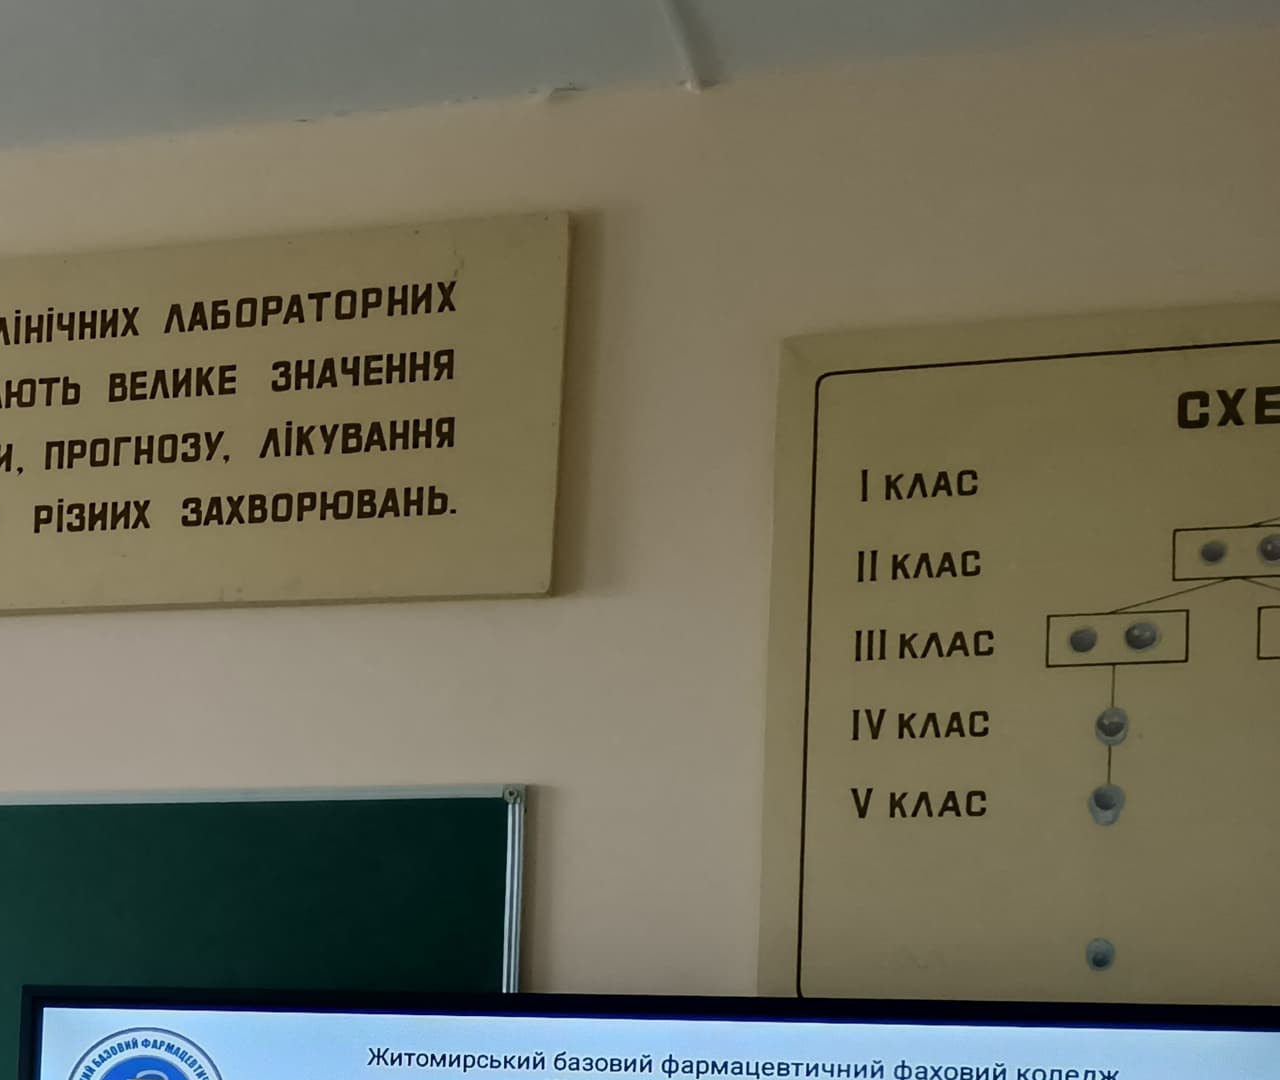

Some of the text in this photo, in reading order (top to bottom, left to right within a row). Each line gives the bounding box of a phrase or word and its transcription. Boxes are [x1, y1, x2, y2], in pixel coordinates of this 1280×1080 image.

[164, 281, 456, 333] ЛАБОРАТОРНИХ
[109, 365, 236, 402] ВЕЛИКЕ
[272, 349, 454, 392] ЗНАЧЕННЯ
[45, 431, 229, 470] ПРОГНОЗУ,
[259, 417, 455, 458] ЛІКУВАННЯ
[885, 470, 978, 500] КЛАС
[34, 499, 150, 533] РІЗНИХ
[182, 486, 456, 526] ЗАХВОРЮВАНЬ.
[892, 551, 980, 580] КЛАС
[899, 631, 994, 659] КЛАС
[898, 711, 989, 739] КЛАС
[851, 788, 986, 818] V КЛАС
[93, 1036, 139, 1068] БАЗОВИЙ
[368, 1048, 544, 1072] Житомирський
[554, 1052, 652, 1072] базовий
[662, 1054, 883, 1079] фармацевтичний
